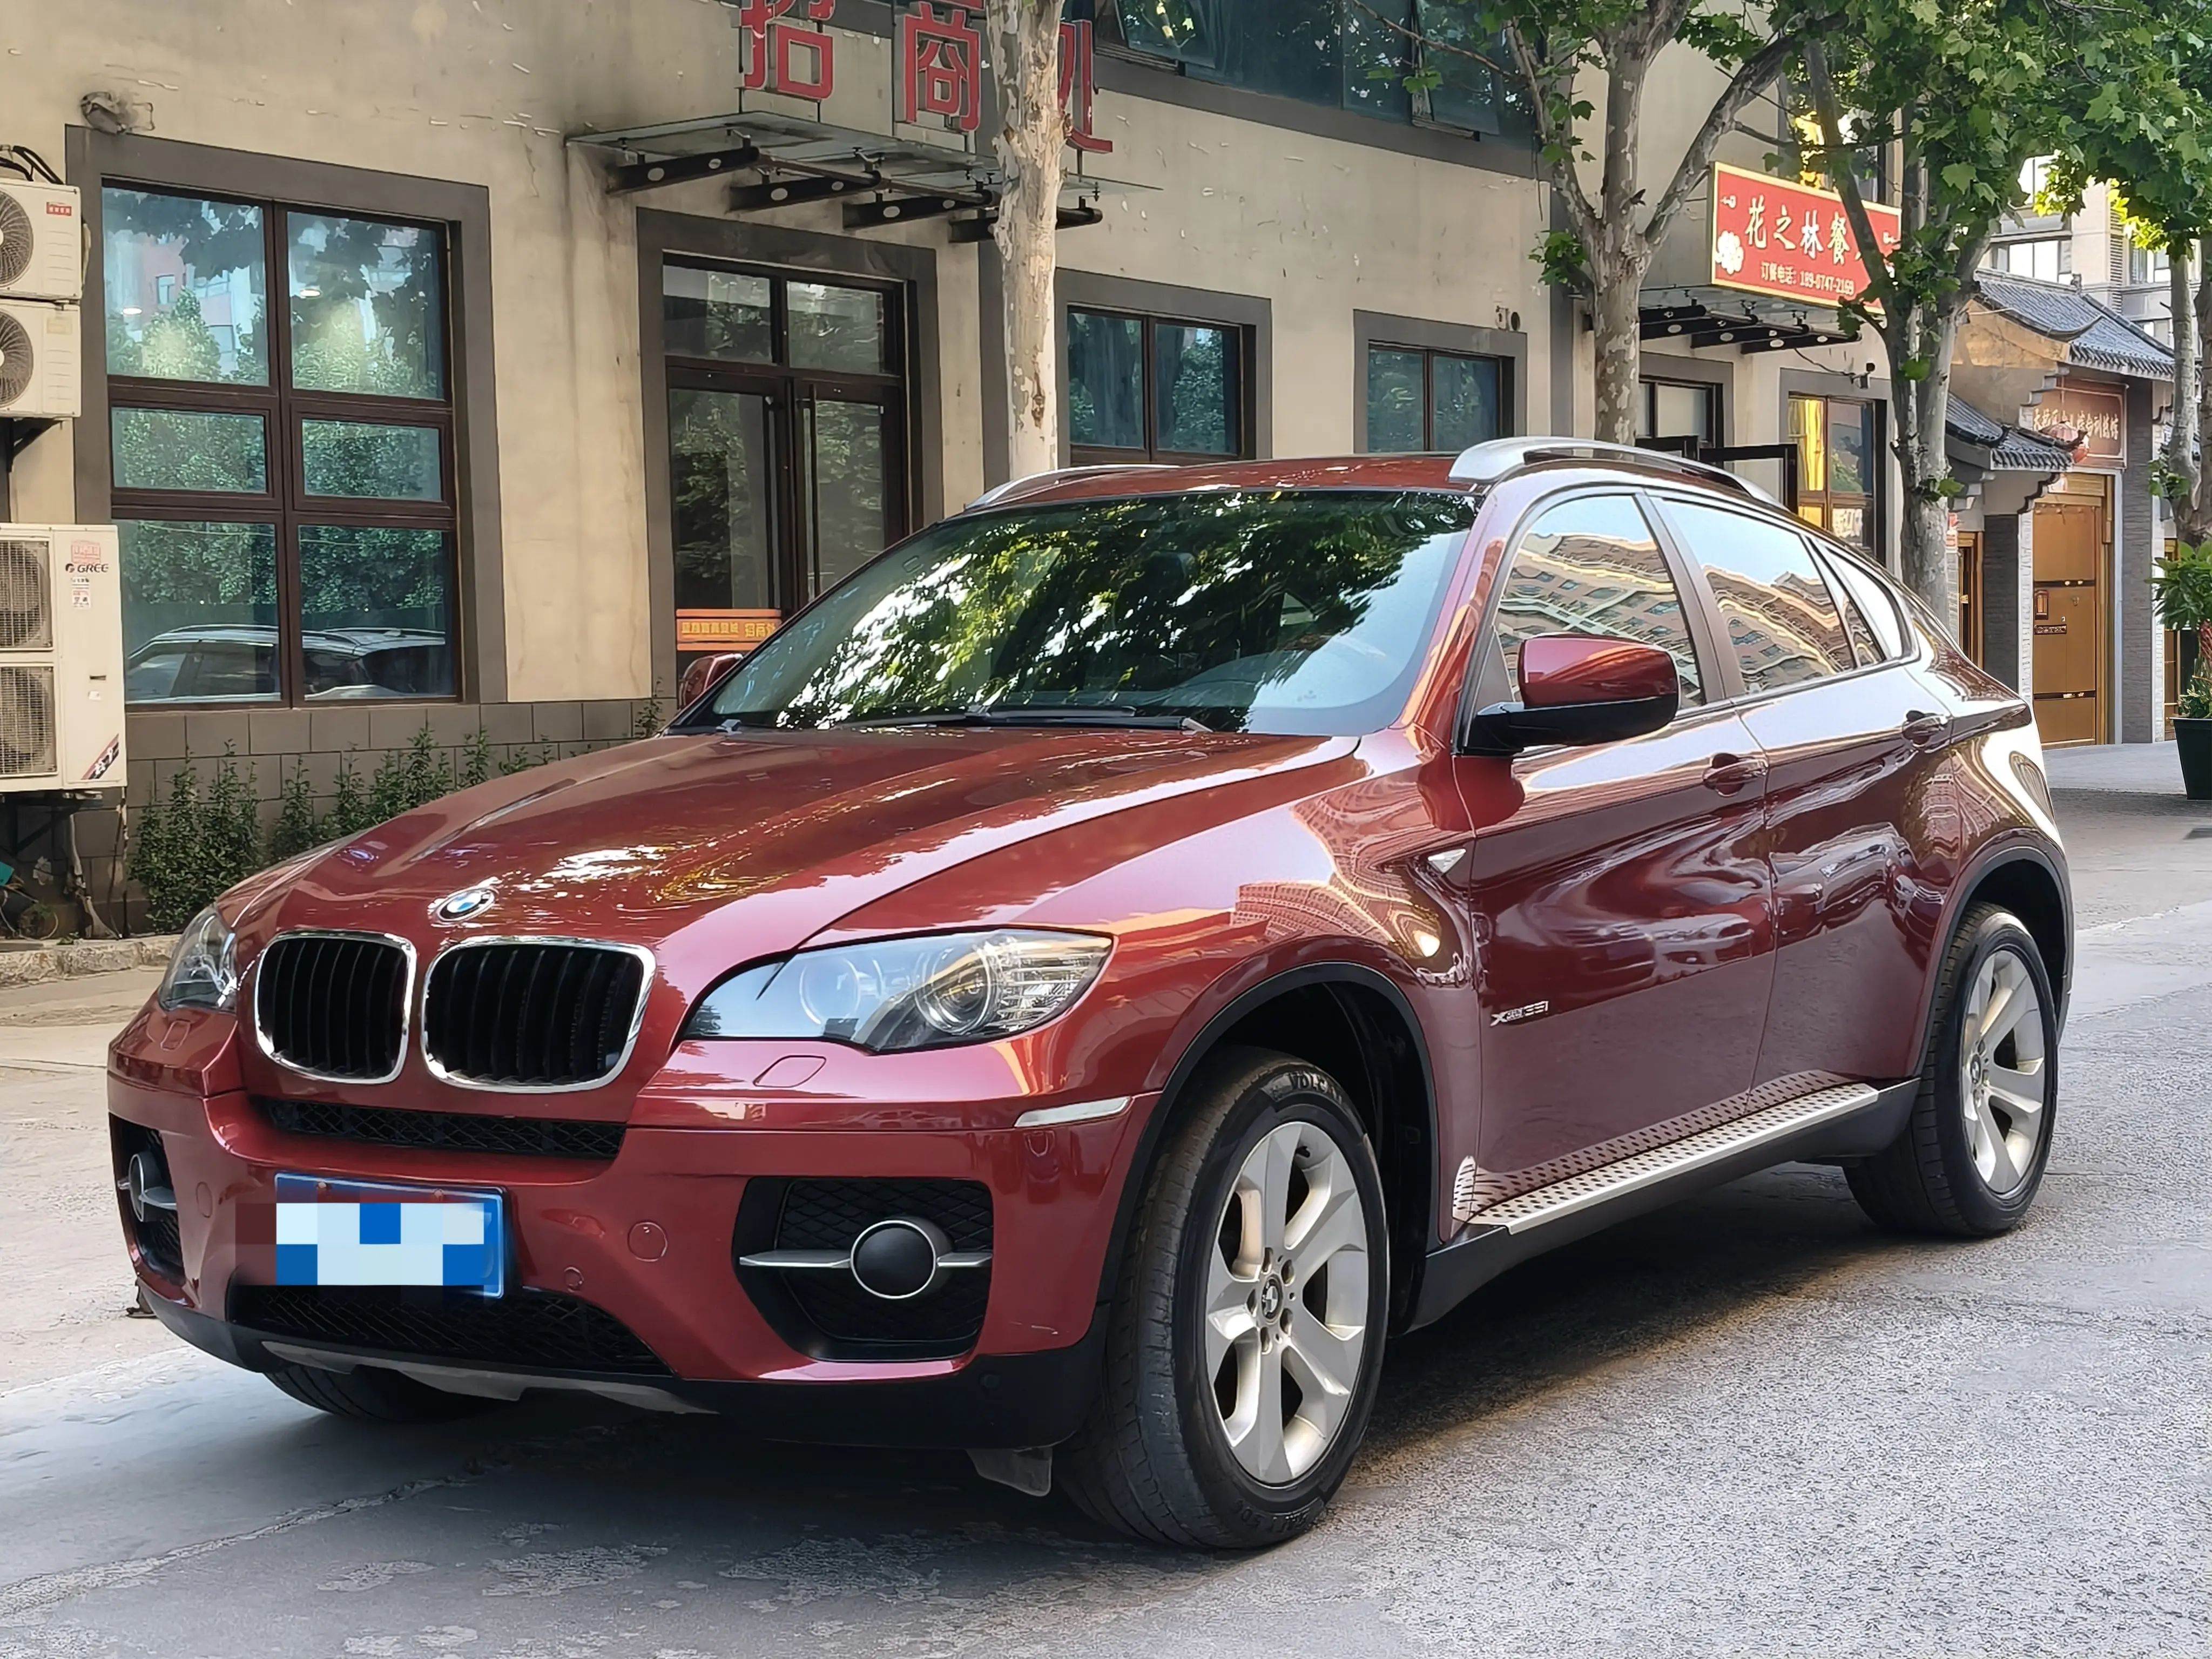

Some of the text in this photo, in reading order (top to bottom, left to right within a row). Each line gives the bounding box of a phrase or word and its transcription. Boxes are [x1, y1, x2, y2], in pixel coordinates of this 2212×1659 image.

[1745, 194, 1862, 265] 花之林餐
[77, 563, 109, 573] GREE
